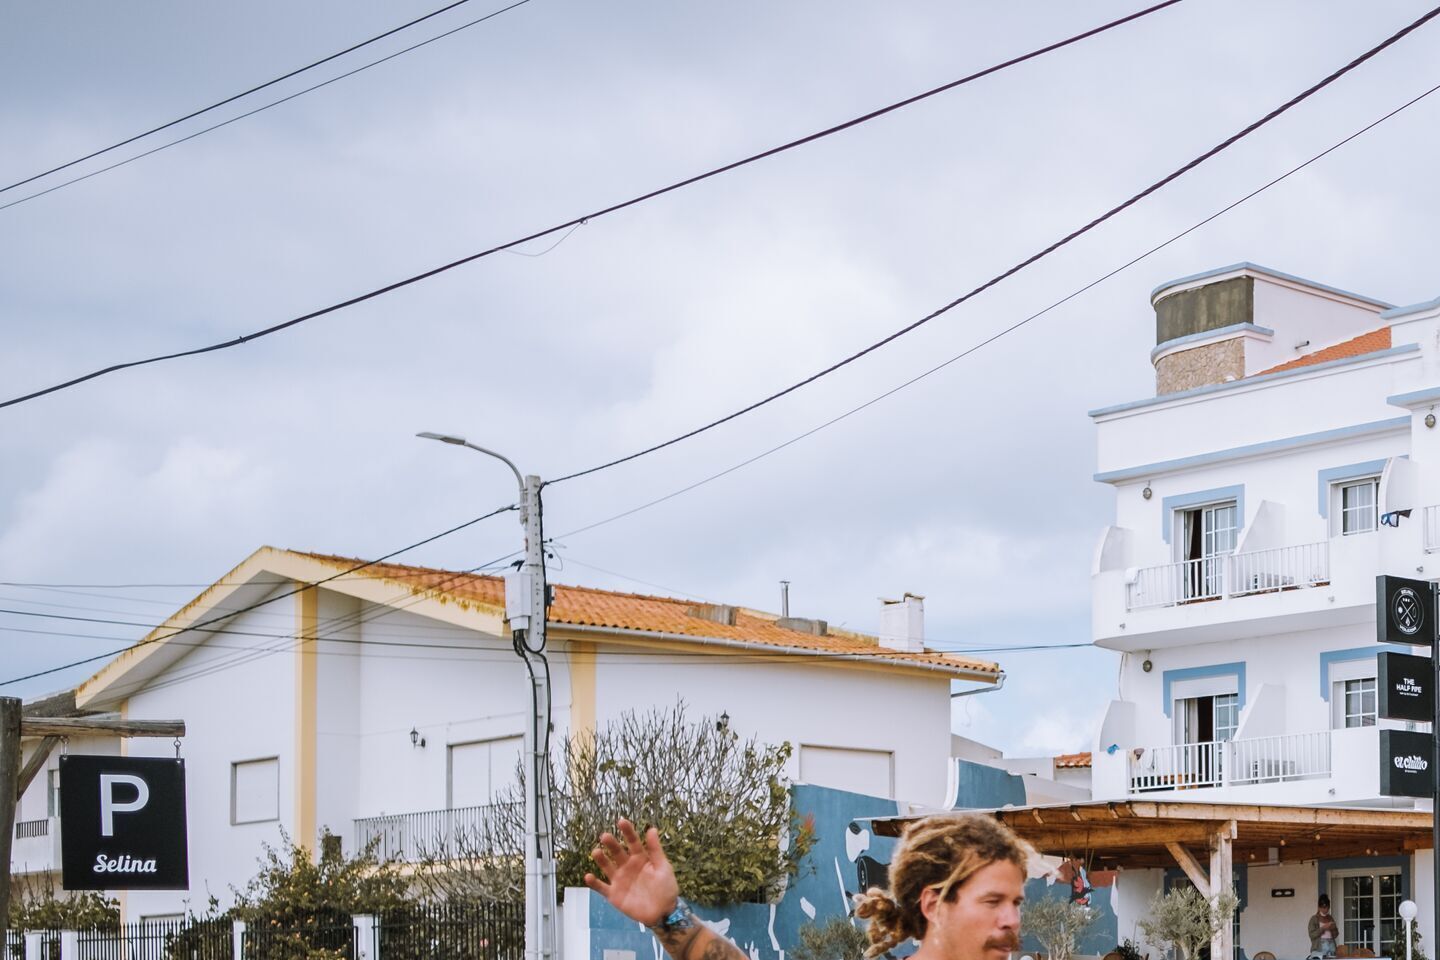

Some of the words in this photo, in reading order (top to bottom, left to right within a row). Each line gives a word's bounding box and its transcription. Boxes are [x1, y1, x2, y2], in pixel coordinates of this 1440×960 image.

[1396, 683, 1411, 691] HALF
[1403, 677, 1415, 685] THE
[100, 774, 149, 836] P
[93, 854, 157, 873] Selina
